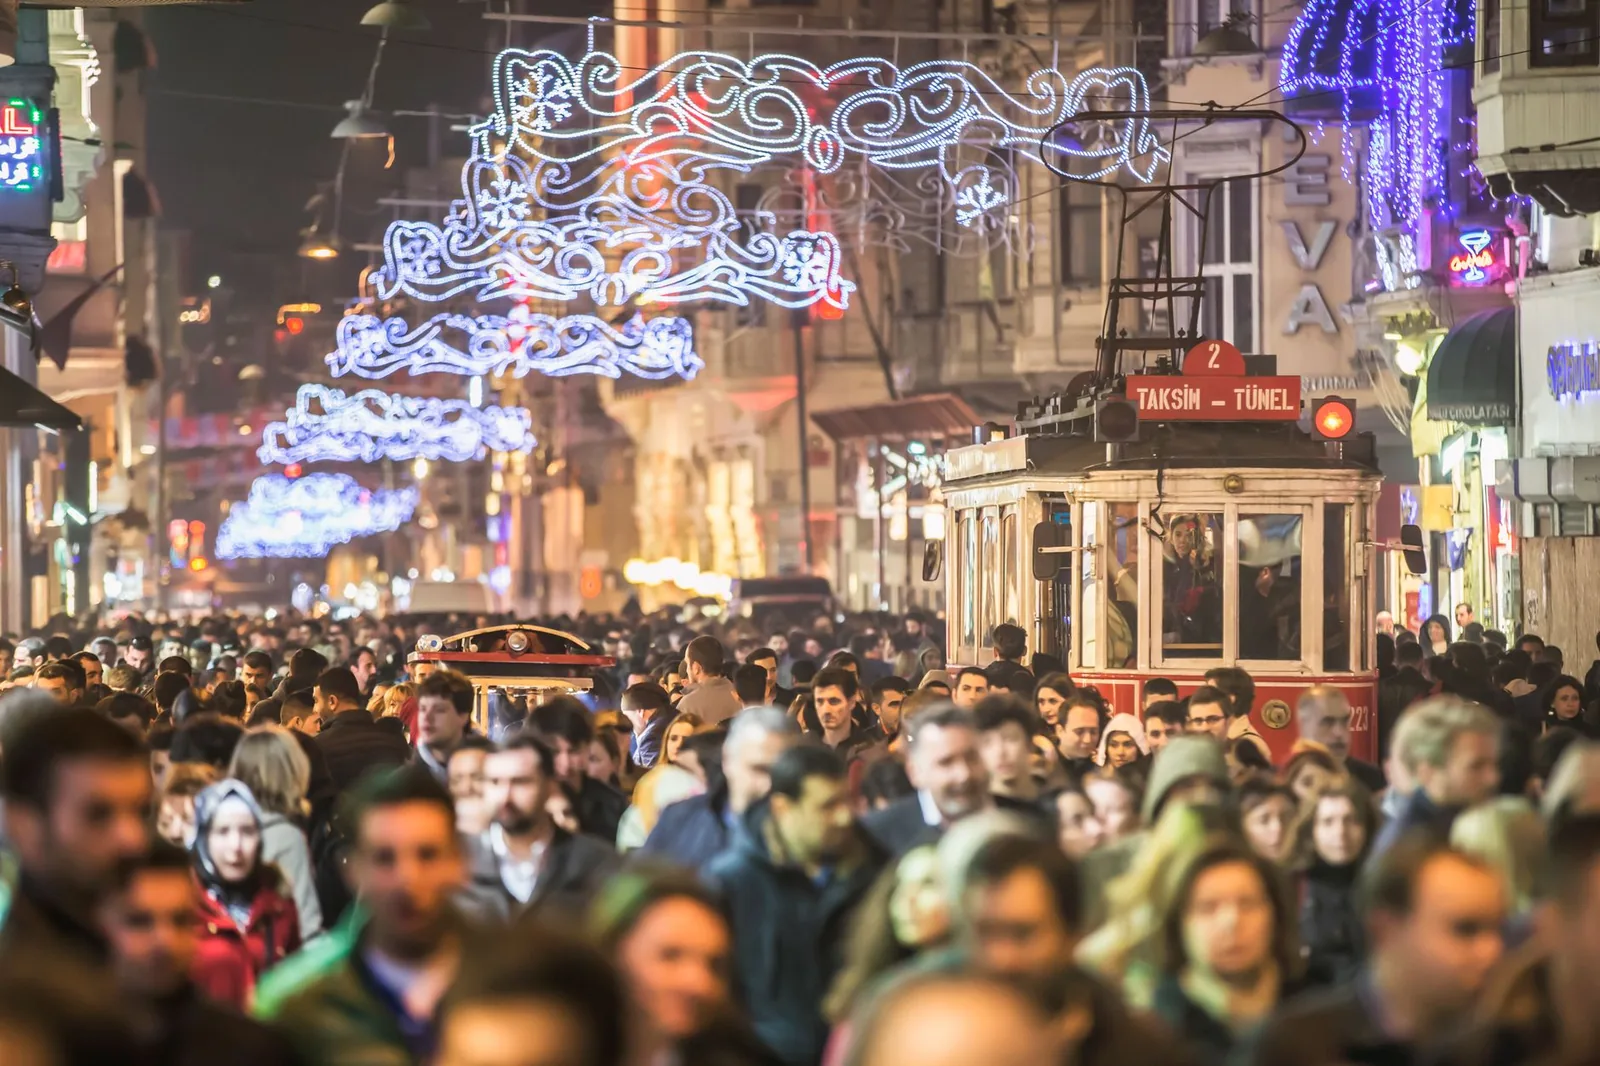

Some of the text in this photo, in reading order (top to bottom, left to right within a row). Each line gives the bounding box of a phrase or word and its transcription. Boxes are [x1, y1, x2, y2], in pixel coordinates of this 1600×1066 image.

[1281, 124, 1341, 335] EVA
[1208, 343, 1220, 369] 2
[1136, 384, 1201, 411] TAKSİM
[1234, 384, 1294, 411] TÜNEL
